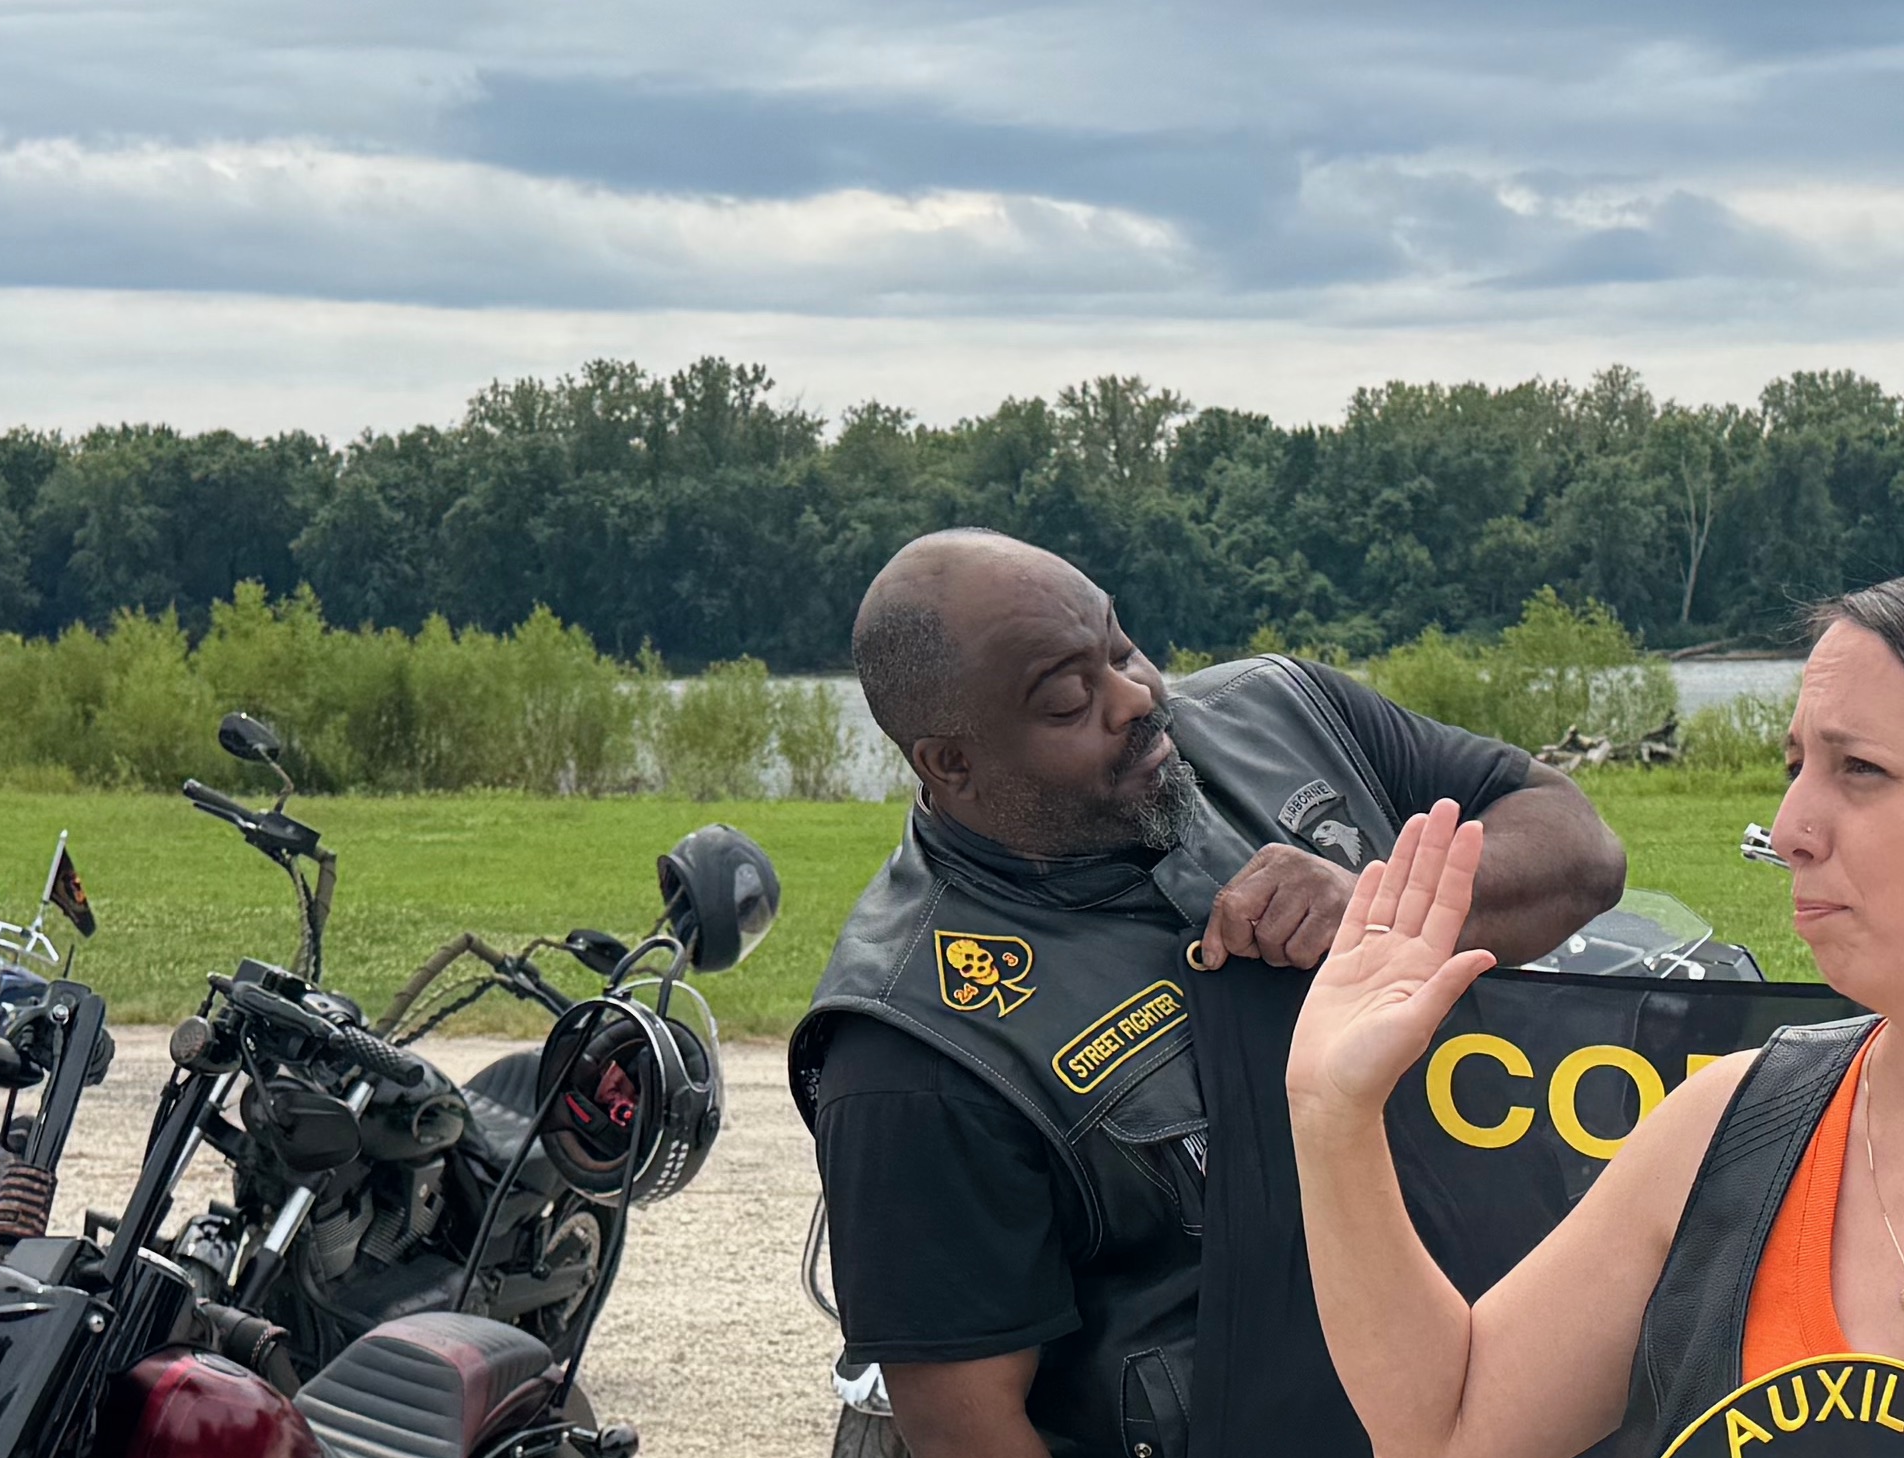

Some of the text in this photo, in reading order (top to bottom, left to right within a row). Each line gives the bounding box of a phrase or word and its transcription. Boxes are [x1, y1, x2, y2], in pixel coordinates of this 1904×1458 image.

[1285, 784, 1329, 826] AIRBORNE
[1068, 993, 1181, 1078] STREET FIGHTER
